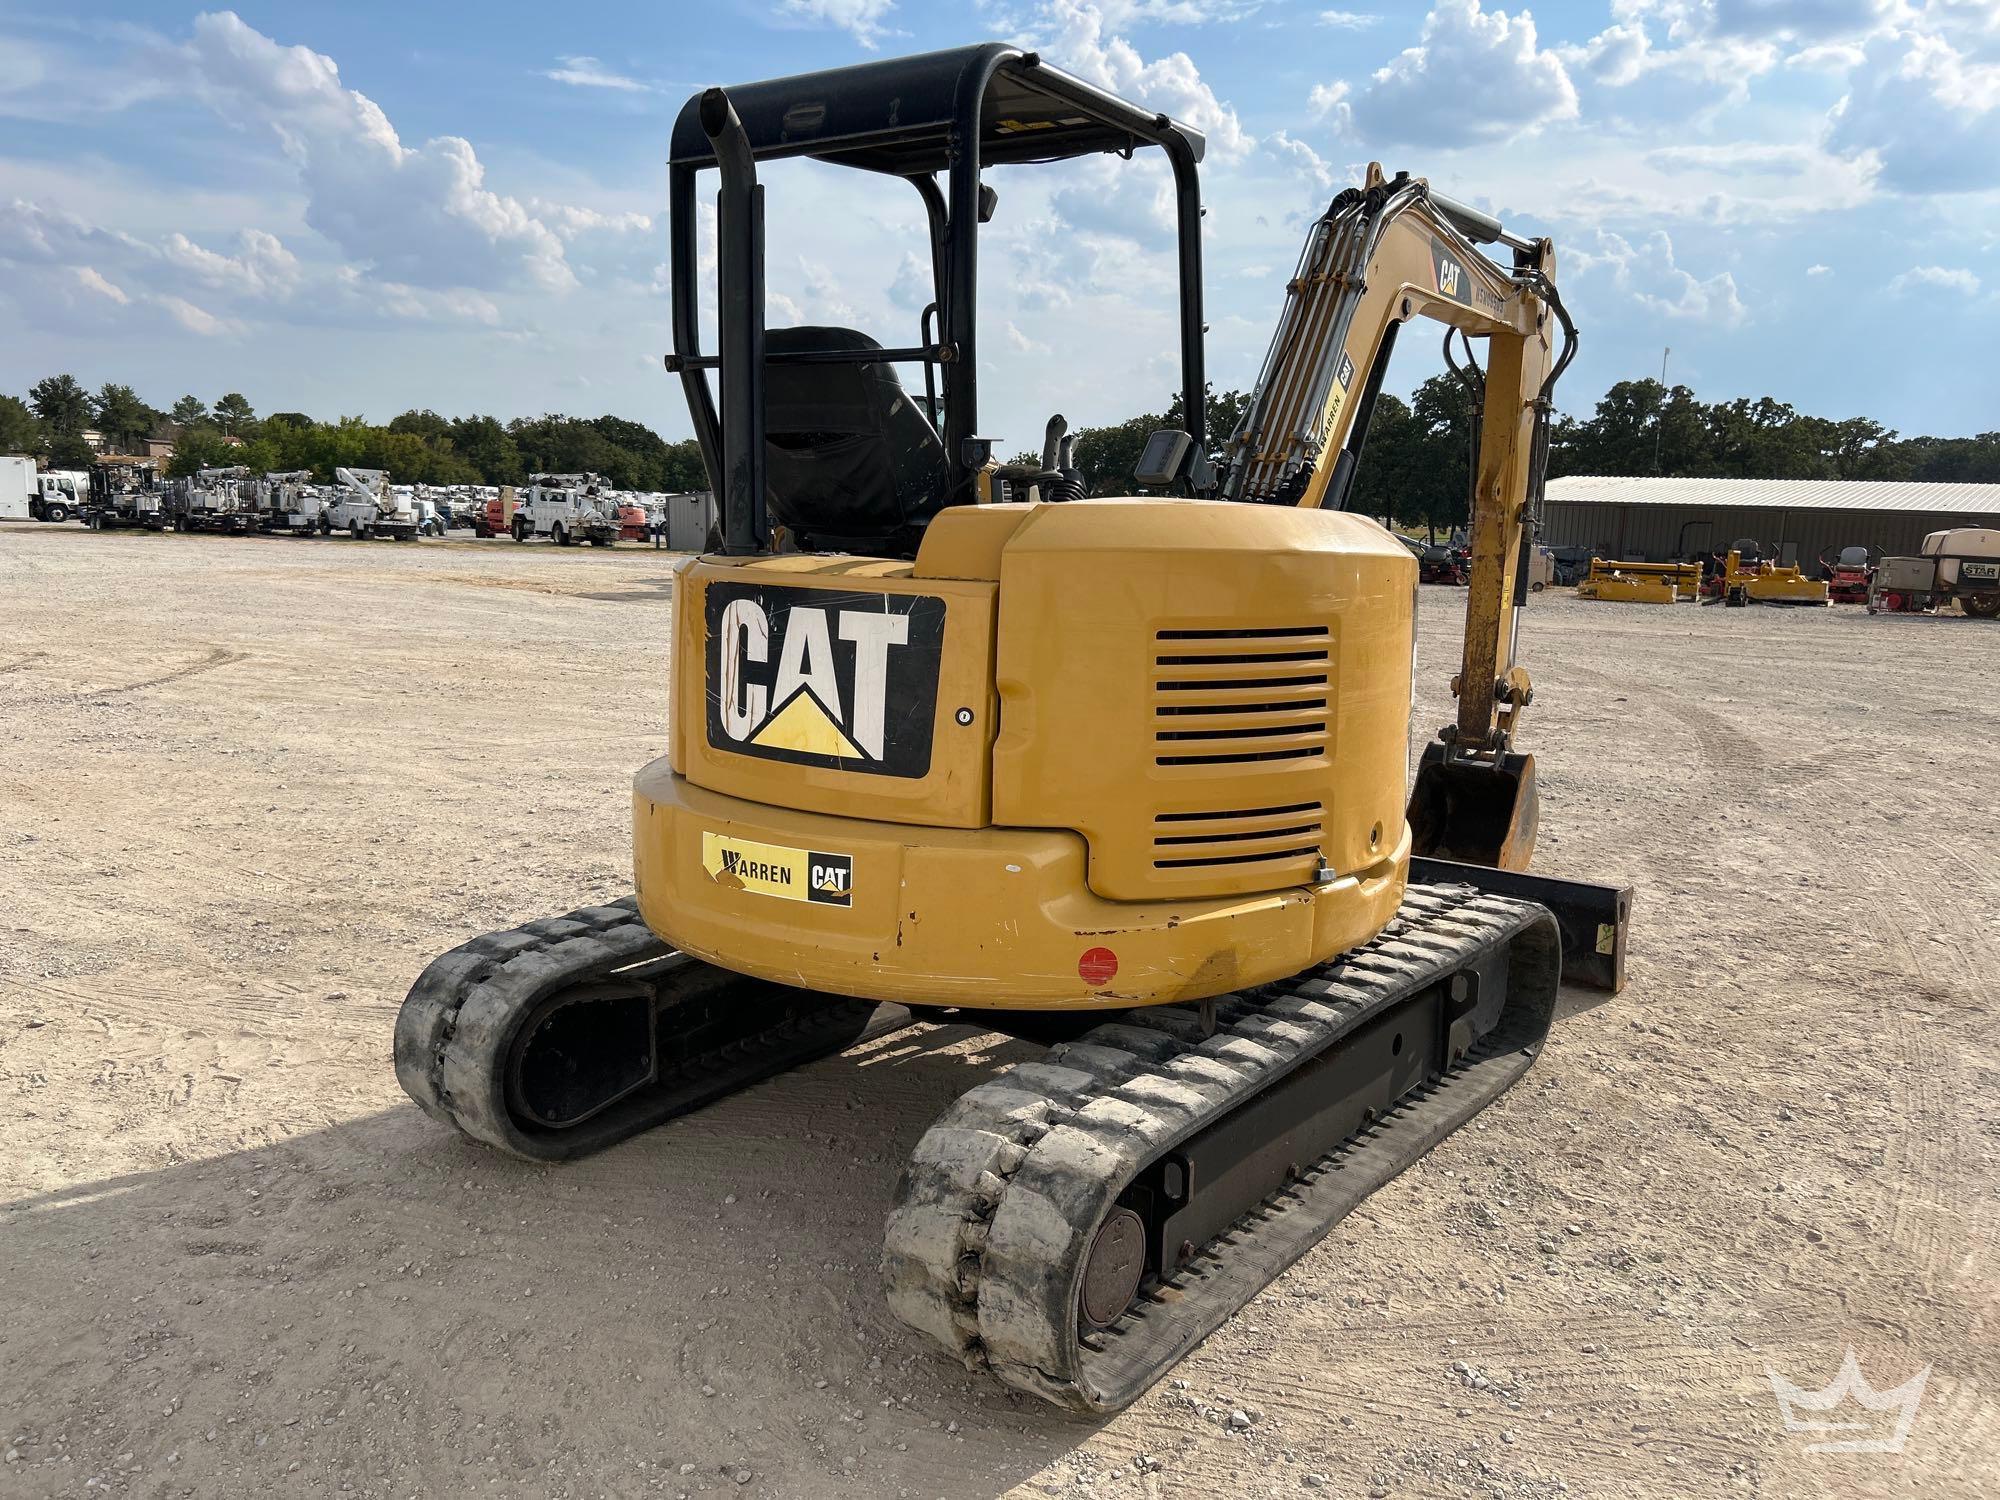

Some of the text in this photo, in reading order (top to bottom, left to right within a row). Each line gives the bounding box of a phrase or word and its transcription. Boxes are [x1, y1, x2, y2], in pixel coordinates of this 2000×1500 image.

[1440, 259, 1461, 297] CAT
[1320, 359, 1352, 449] WARREN CAT
[1965, 567, 1996, 575] STAR
[720, 599, 909, 762] CAT
[721, 848, 850, 892] WARREN CAT
